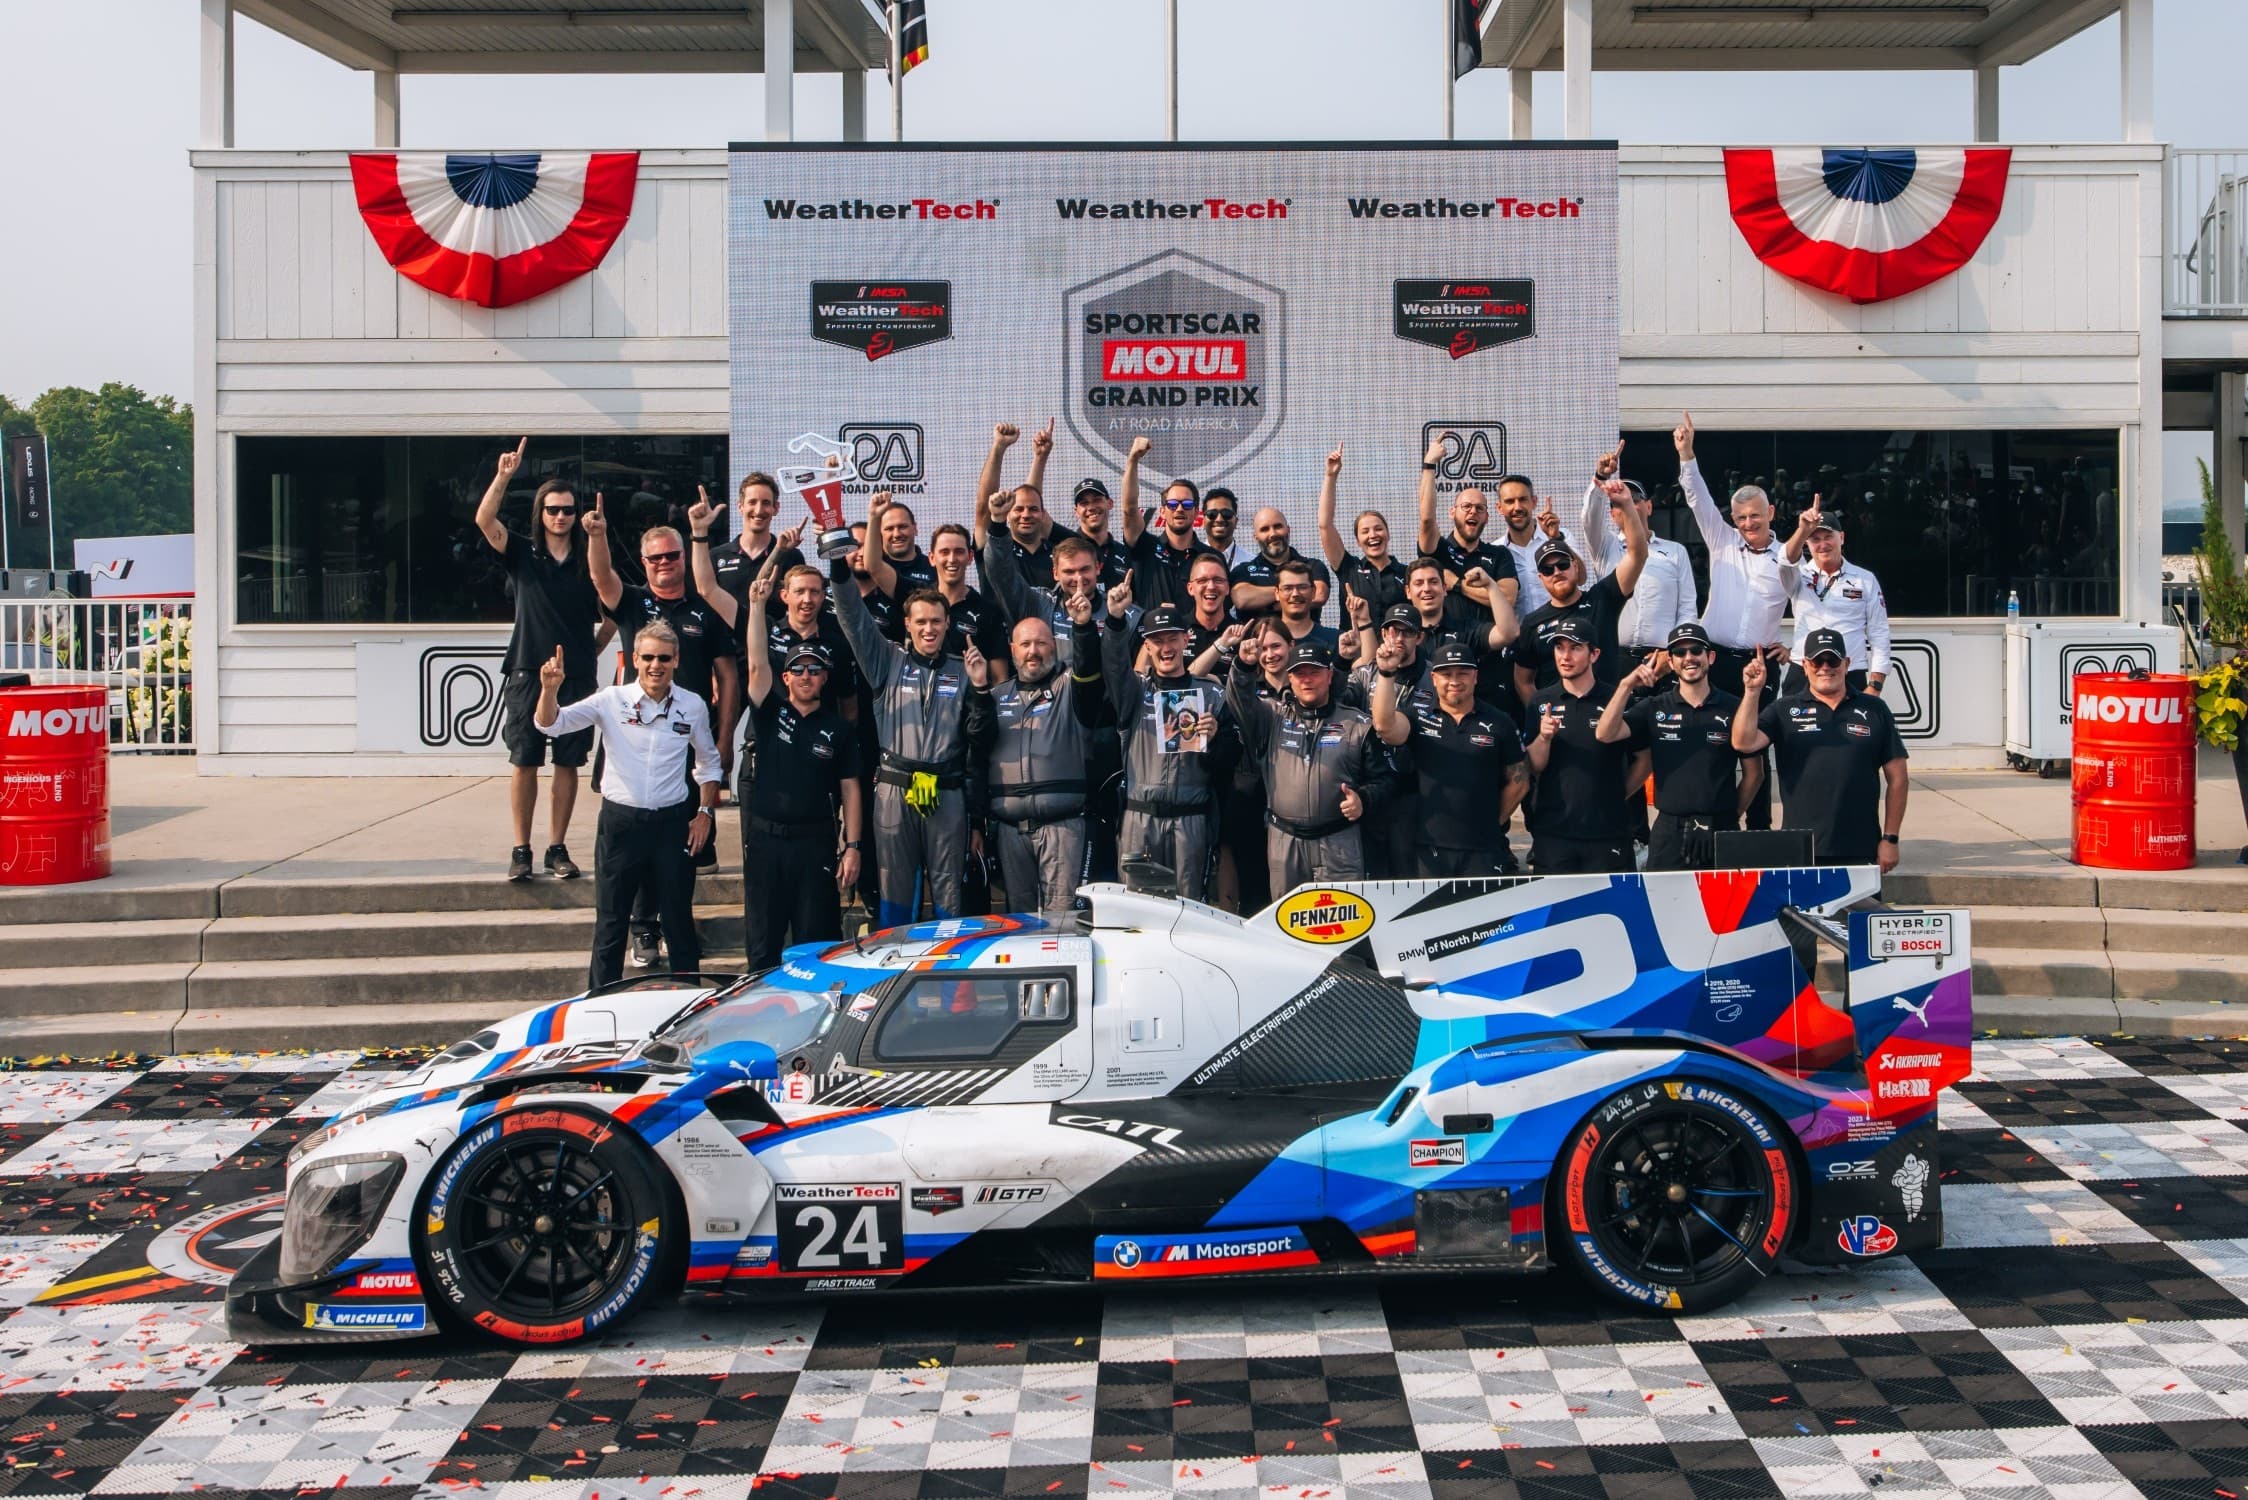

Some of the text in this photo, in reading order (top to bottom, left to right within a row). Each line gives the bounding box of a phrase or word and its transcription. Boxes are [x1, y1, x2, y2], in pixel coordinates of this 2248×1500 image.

[1086, 313, 1261, 334] SPORTSCAR
[1110, 346, 1239, 375] MOTUL
[1088, 386, 1259, 407] GRAND PRIX
[1109, 418, 1239, 430] AT ROAD AMERICA
[873, 484, 924, 494] AMERICA
[1455, 482, 1499, 493] AMERIC
[2076, 694, 2183, 724] MOTUL
[8, 705, 109, 737] MOTU
[3, 775, 52, 784] INGENIOUS
[54, 775, 62, 802] BLEND
[2148, 834, 2188, 844] AUTHENTIC
[1289, 904, 1360, 929] PENNZOIL
[1879, 918, 1944, 928] HYBRID
[1398, 921, 1515, 962] BMW of North America
[1901, 940, 1942, 951] BOSCH
[1193, 1047, 1241, 1086] ULTIMATE
[1239, 1006, 1297, 1051] ELECTRIFIED
[1295, 1000, 1307, 1012] M
[1305, 976, 1339, 1005] POWER
[770, 1091, 781, 1103] N
[790, 1082, 803, 1099] E
[1698, 1089, 1772, 1143] MICHELIN
[1057, 1114, 1186, 1155] CATL
[1584, 1132, 1596, 1148] H
[1413, 1148, 1462, 1159] CHAMPION
[435, 1127, 495, 1202] MICHELIN
[999, 1188, 1044, 1200] GTP
[795, 1205, 887, 1268] 24
[1767, 1237, 1779, 1249] H
[1840, 1215, 1881, 1255] VP
[1196, 1236, 1292, 1260] Motorsport
[1580, 1240, 1651, 1300] MICHELIN
[360, 1274, 413, 1288] MOTUL
[592, 1251, 654, 1327] MICHELIN
[817, 1278, 876, 1288] FAST TRACK
[336, 1313, 414, 1323] MICHELIN
